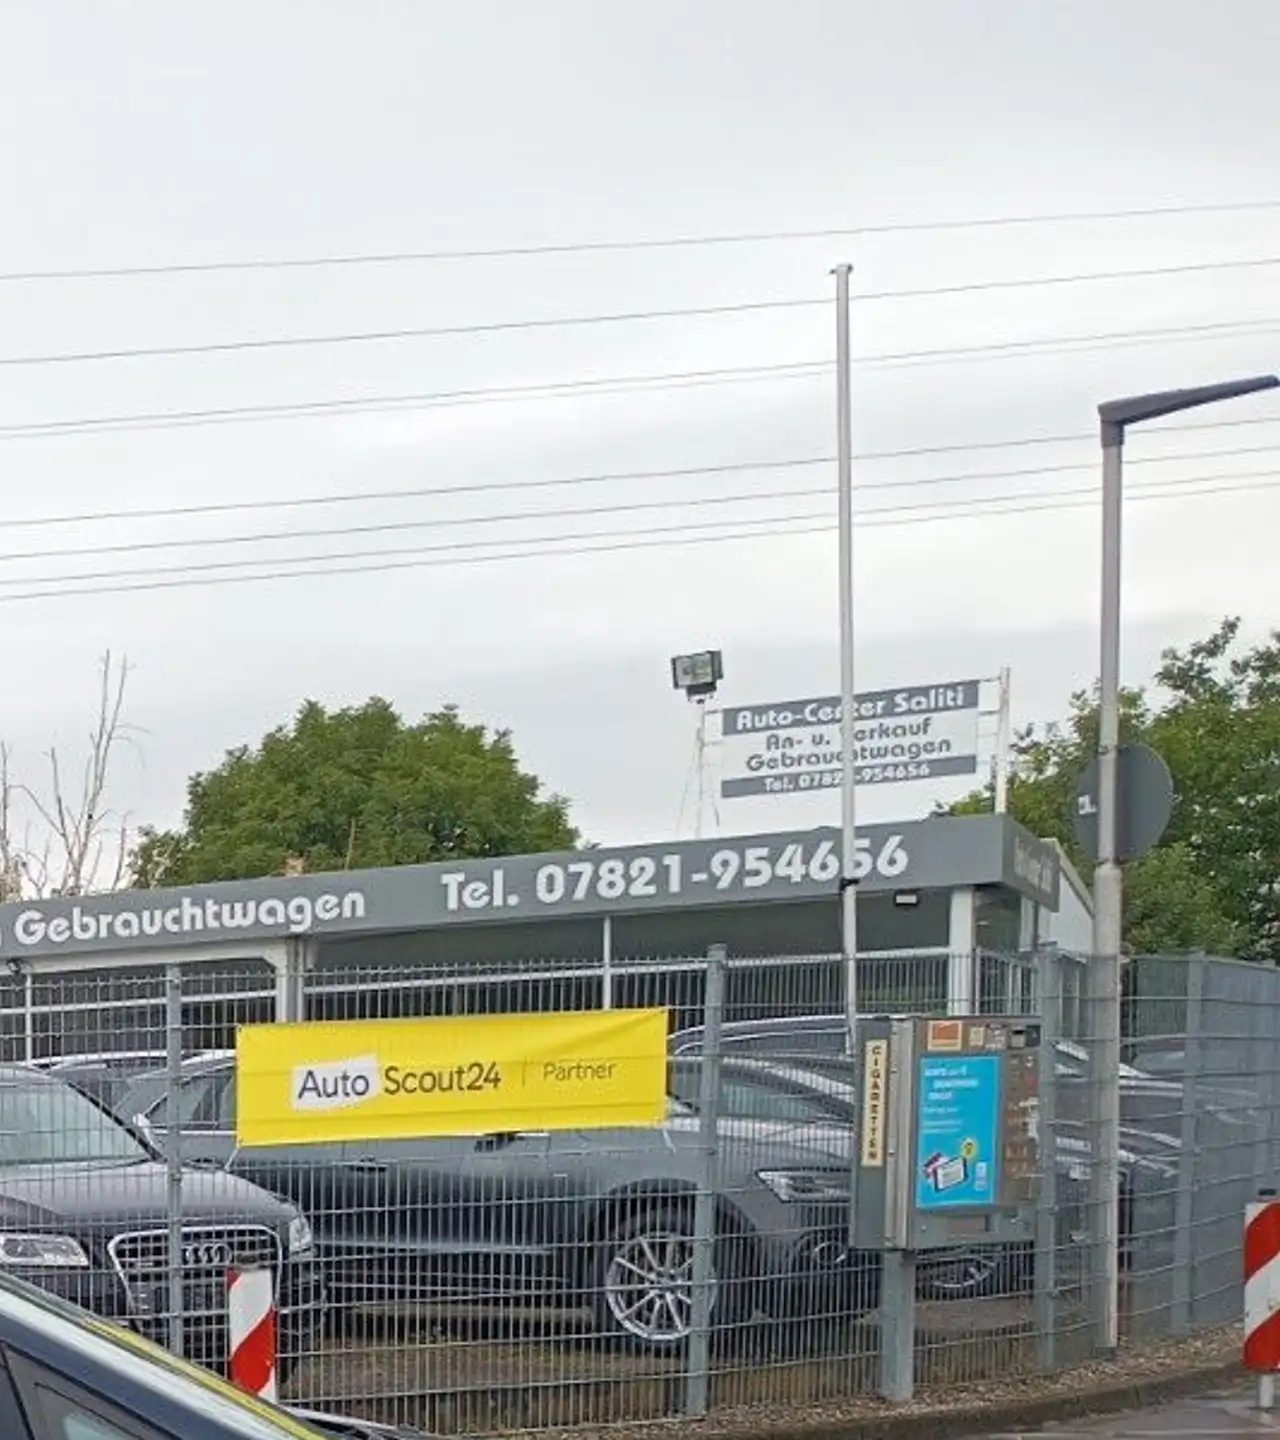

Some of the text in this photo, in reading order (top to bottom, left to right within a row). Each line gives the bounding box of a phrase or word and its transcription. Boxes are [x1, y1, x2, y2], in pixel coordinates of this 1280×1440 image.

[894, 687, 966, 713] Saliti
[766, 717, 933, 751] An- u. erkauf
[764, 764, 931, 792] Tel. 0782-954656
[441, 835, 908, 910] Tel. 07821-954656
[14, 891, 366, 946] Gebrauchtwagen
[297, 1061, 618, 1099] Auto Scout24 Partner
